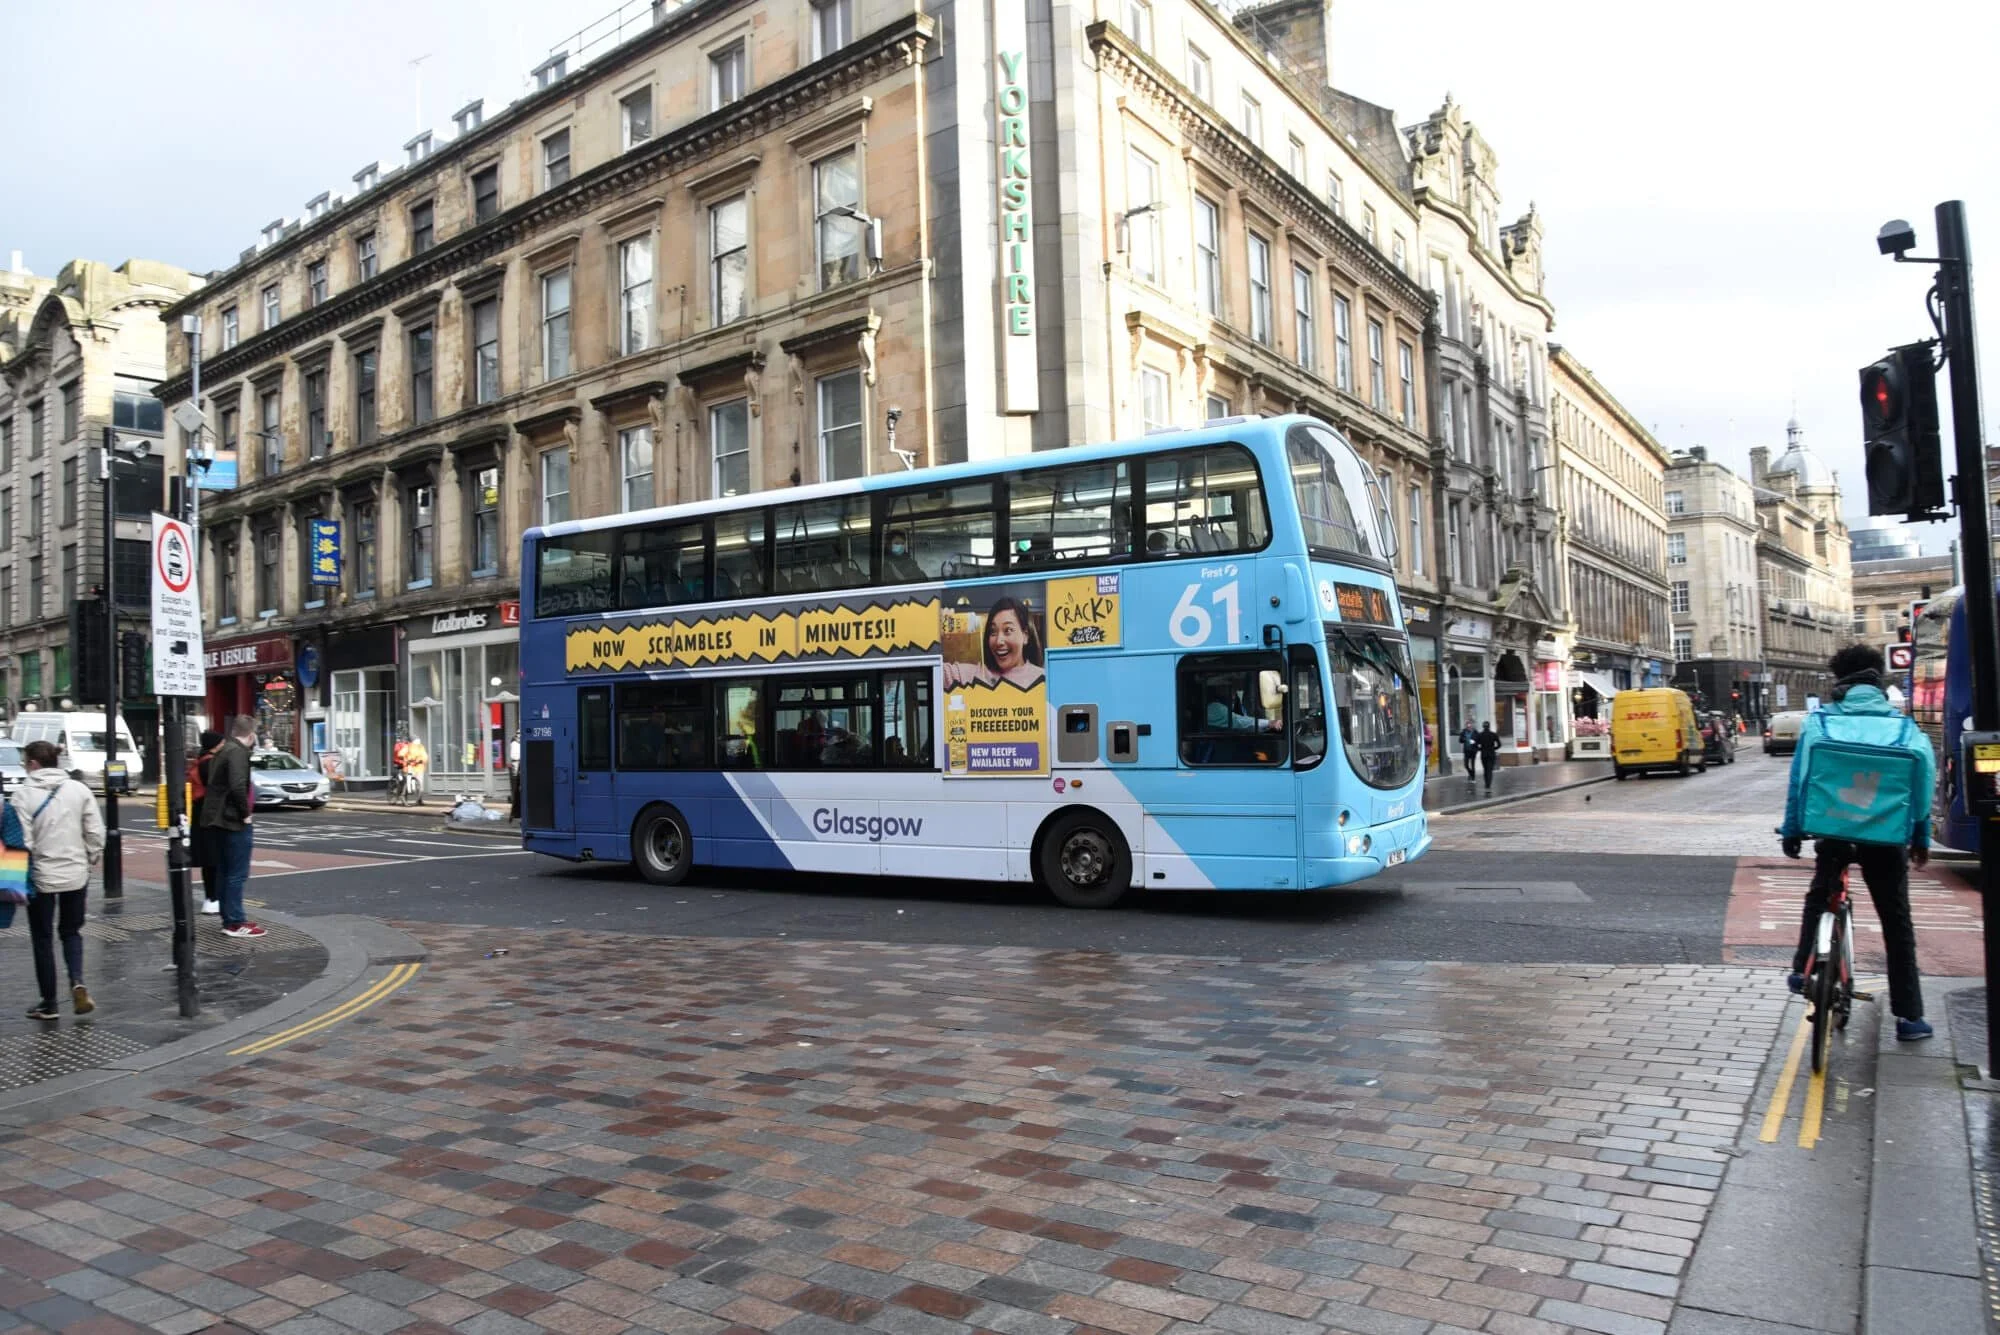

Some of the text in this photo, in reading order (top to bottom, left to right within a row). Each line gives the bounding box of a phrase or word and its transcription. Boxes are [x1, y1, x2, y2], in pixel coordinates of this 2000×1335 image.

[998, 50, 1032, 336] YORKSHIRE
[1201, 567, 1223, 578] First
[1098, 575, 1119, 585] NEW
[1098, 585, 1117, 593] RECIPE
[1054, 597, 1114, 632] CRACKD
[1169, 580, 1240, 648] 61
[432, 609, 488, 634] Ladbrokes
[593, 618, 895, 658] NOW SCRAMBLES IN MINUTES!!
[221, 646, 257, 667] LEISURE
[970, 706, 1034, 718] DISCOVER YOUR
[533, 727, 552, 737] 37196
[970, 719, 1040, 733] FREEEEEDOM
[971, 746, 1017, 757] NEW RECIPE
[971, 758, 1011, 768] AVAILABLE
[1013, 758, 1033, 768] NOW
[813, 807, 923, 842] Glasgow
